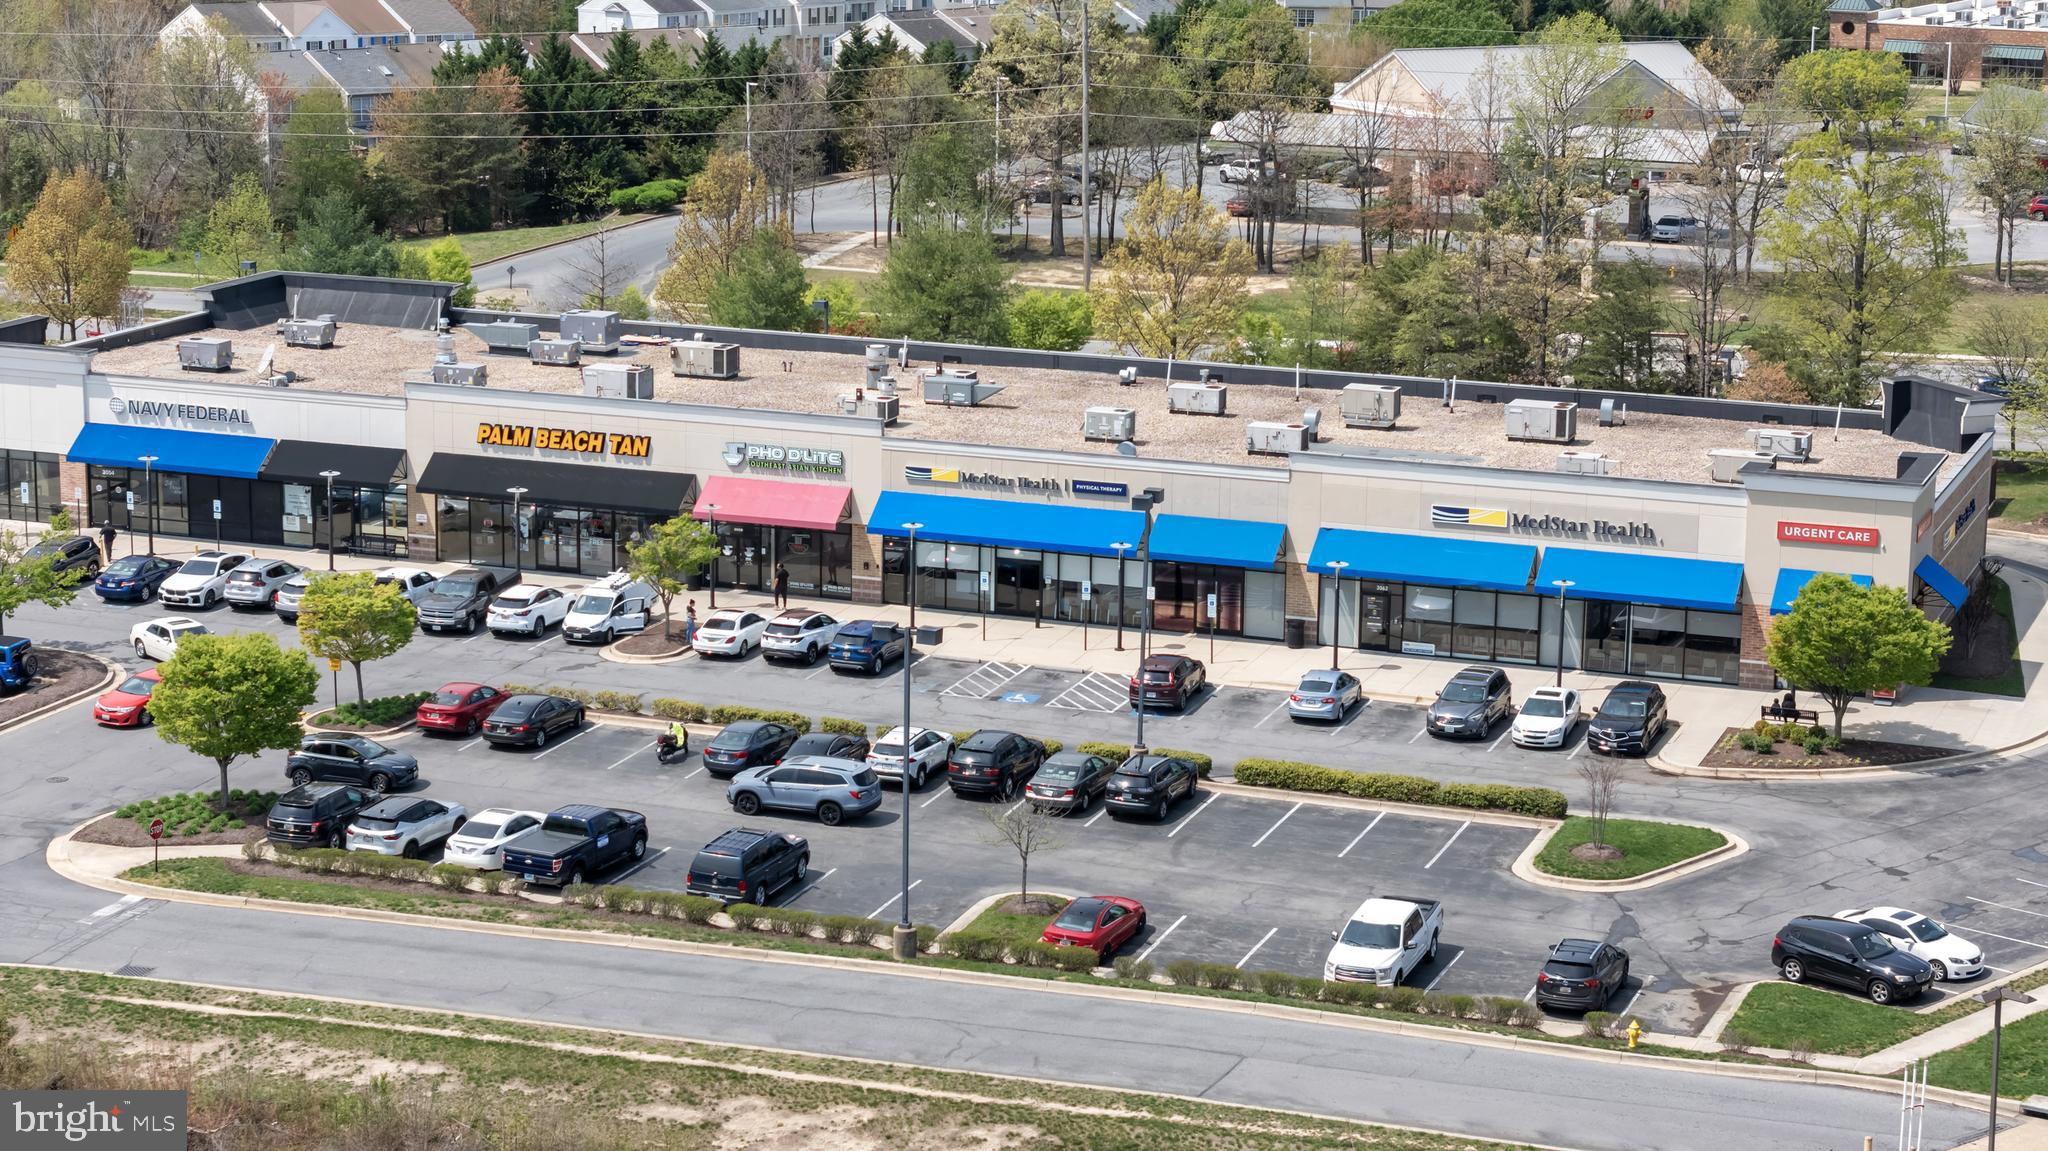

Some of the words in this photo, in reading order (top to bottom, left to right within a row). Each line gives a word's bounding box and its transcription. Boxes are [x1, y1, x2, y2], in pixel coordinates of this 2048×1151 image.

[128, 400, 174, 417] NAVY
[177, 404, 251, 424] FEDERAL
[477, 423, 533, 447] PALM
[535, 427, 606, 453] BEACH
[609, 433, 651, 457] TAN
[747, 443, 786, 461] PHO
[748, 460, 786, 470] SOUTHEAST
[788, 464, 810, 473] ASIAN
[811, 466, 843, 475] KITCHEN
[961, 471, 1015, 487] MedStar
[1017, 476, 1060, 491] Health
[1076, 484, 1100, 492] PHYSICAL
[1512, 513, 1589, 533] MedStar
[1593, 519, 1656, 539] Health
[1784, 526, 1836, 539] URGENT
[1837, 530, 1871, 542] CARE
[150, 824, 163, 835] STOP
